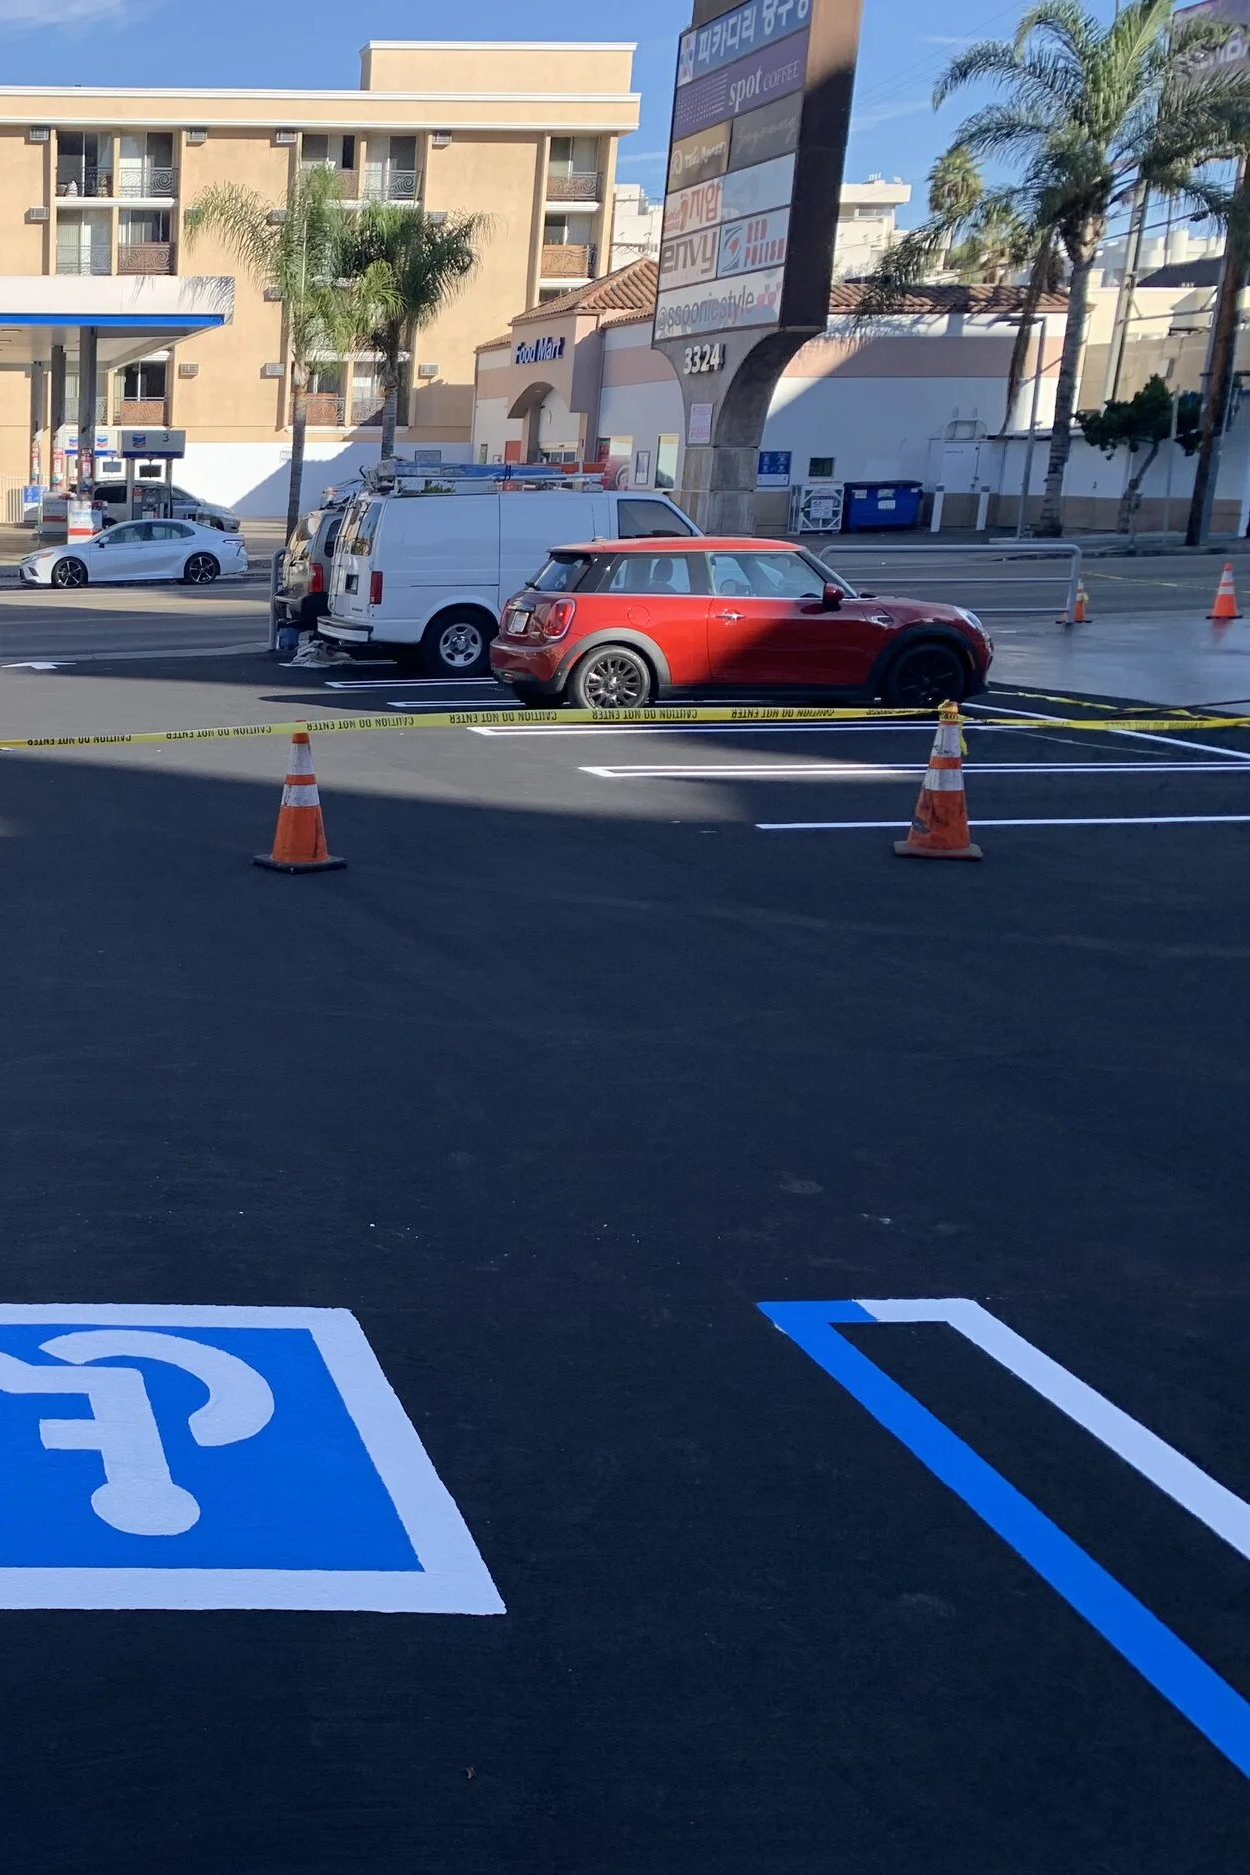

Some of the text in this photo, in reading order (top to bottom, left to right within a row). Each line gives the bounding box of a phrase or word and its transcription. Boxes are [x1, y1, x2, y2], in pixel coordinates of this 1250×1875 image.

[697, 5, 756, 64] 피카디리
[728, 60, 801, 113] spot COFFEE
[746, 218, 767, 244] RED
[661, 231, 718, 275] envy
[743, 238, 785, 267] POLISH
[516, 336, 565, 364] Food Mart
[683, 342, 723, 375] 3324
[162, 433, 170, 443] 3
[306, 716, 415, 731] CAUTION DO NOT ENTER
[449, 710, 557, 724] CAUTION DO NOT ENTER
[591, 708, 698, 720] CAUTION DO NOT ENTER
